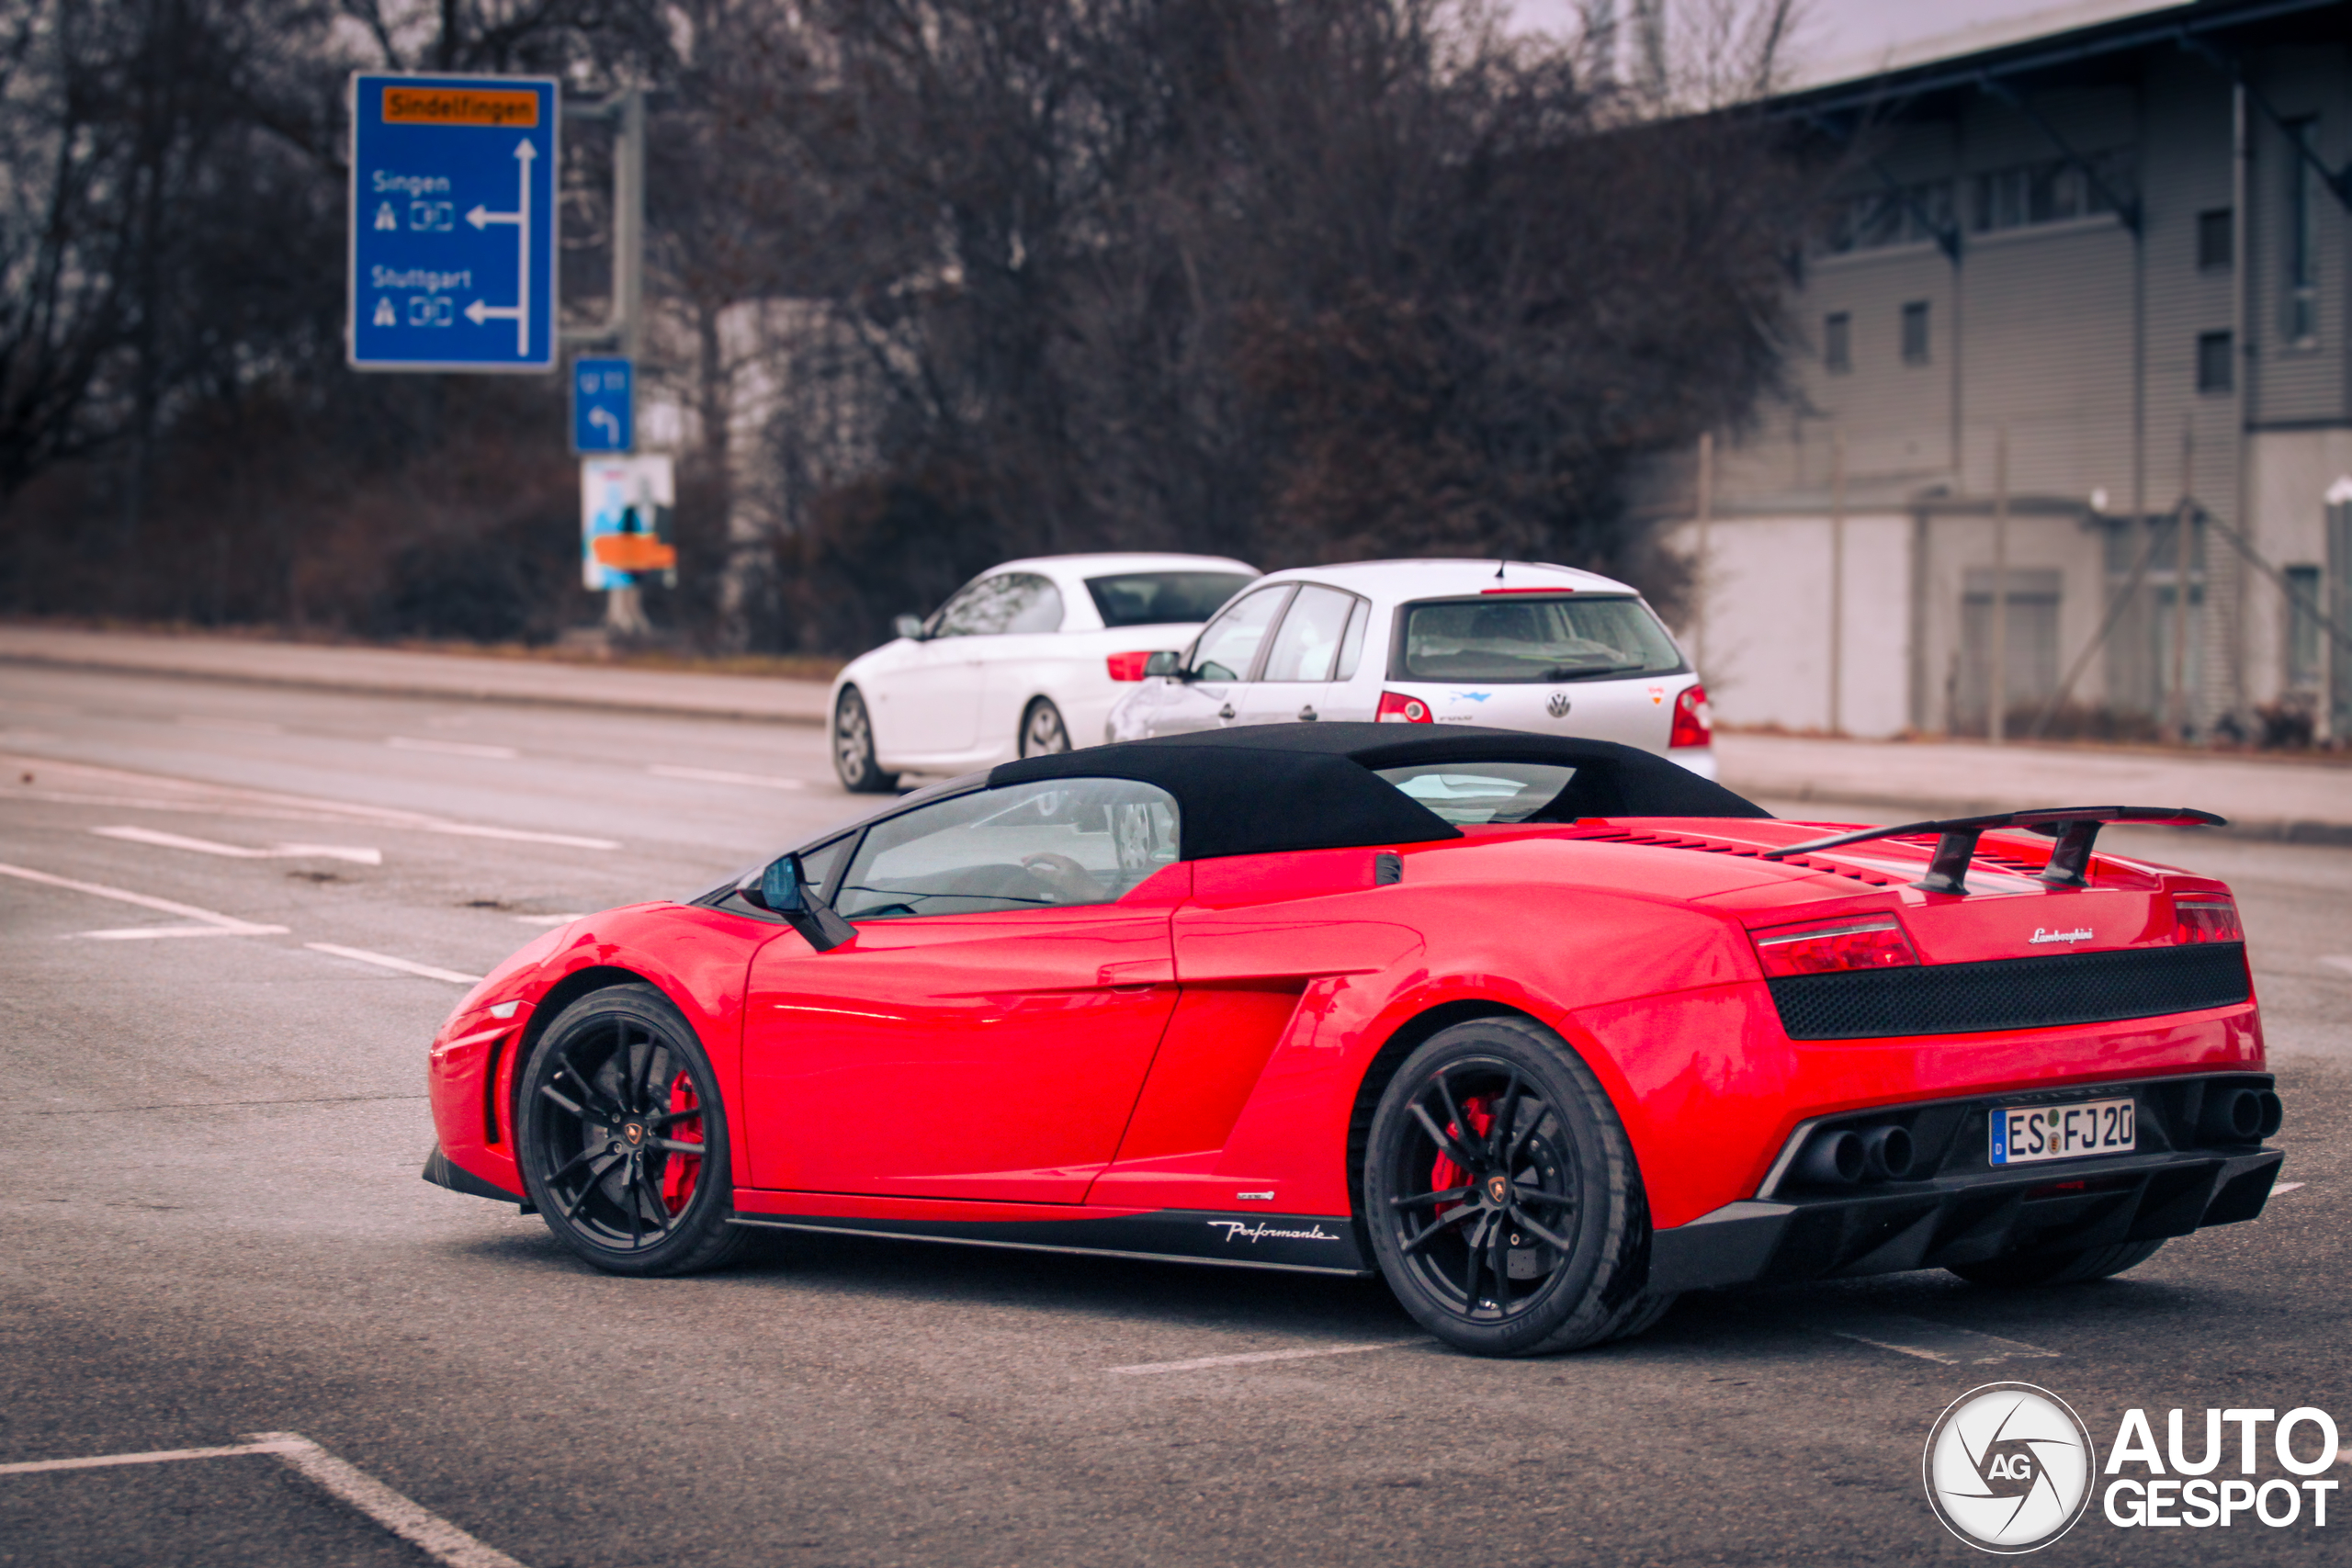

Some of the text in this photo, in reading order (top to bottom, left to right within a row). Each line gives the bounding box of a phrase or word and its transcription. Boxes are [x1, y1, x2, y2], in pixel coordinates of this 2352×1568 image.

[390, 94, 533, 123] Sindelfingen
[372, 169, 451, 197] Singen
[371, 265, 472, 294] Stuttgart
[2028, 927, 2094, 945] Lamborghini
[2008, 1112, 2045, 1156] ES
[1995, 1142, 2004, 1156] D
[1206, 1221, 1340, 1244] Performante
